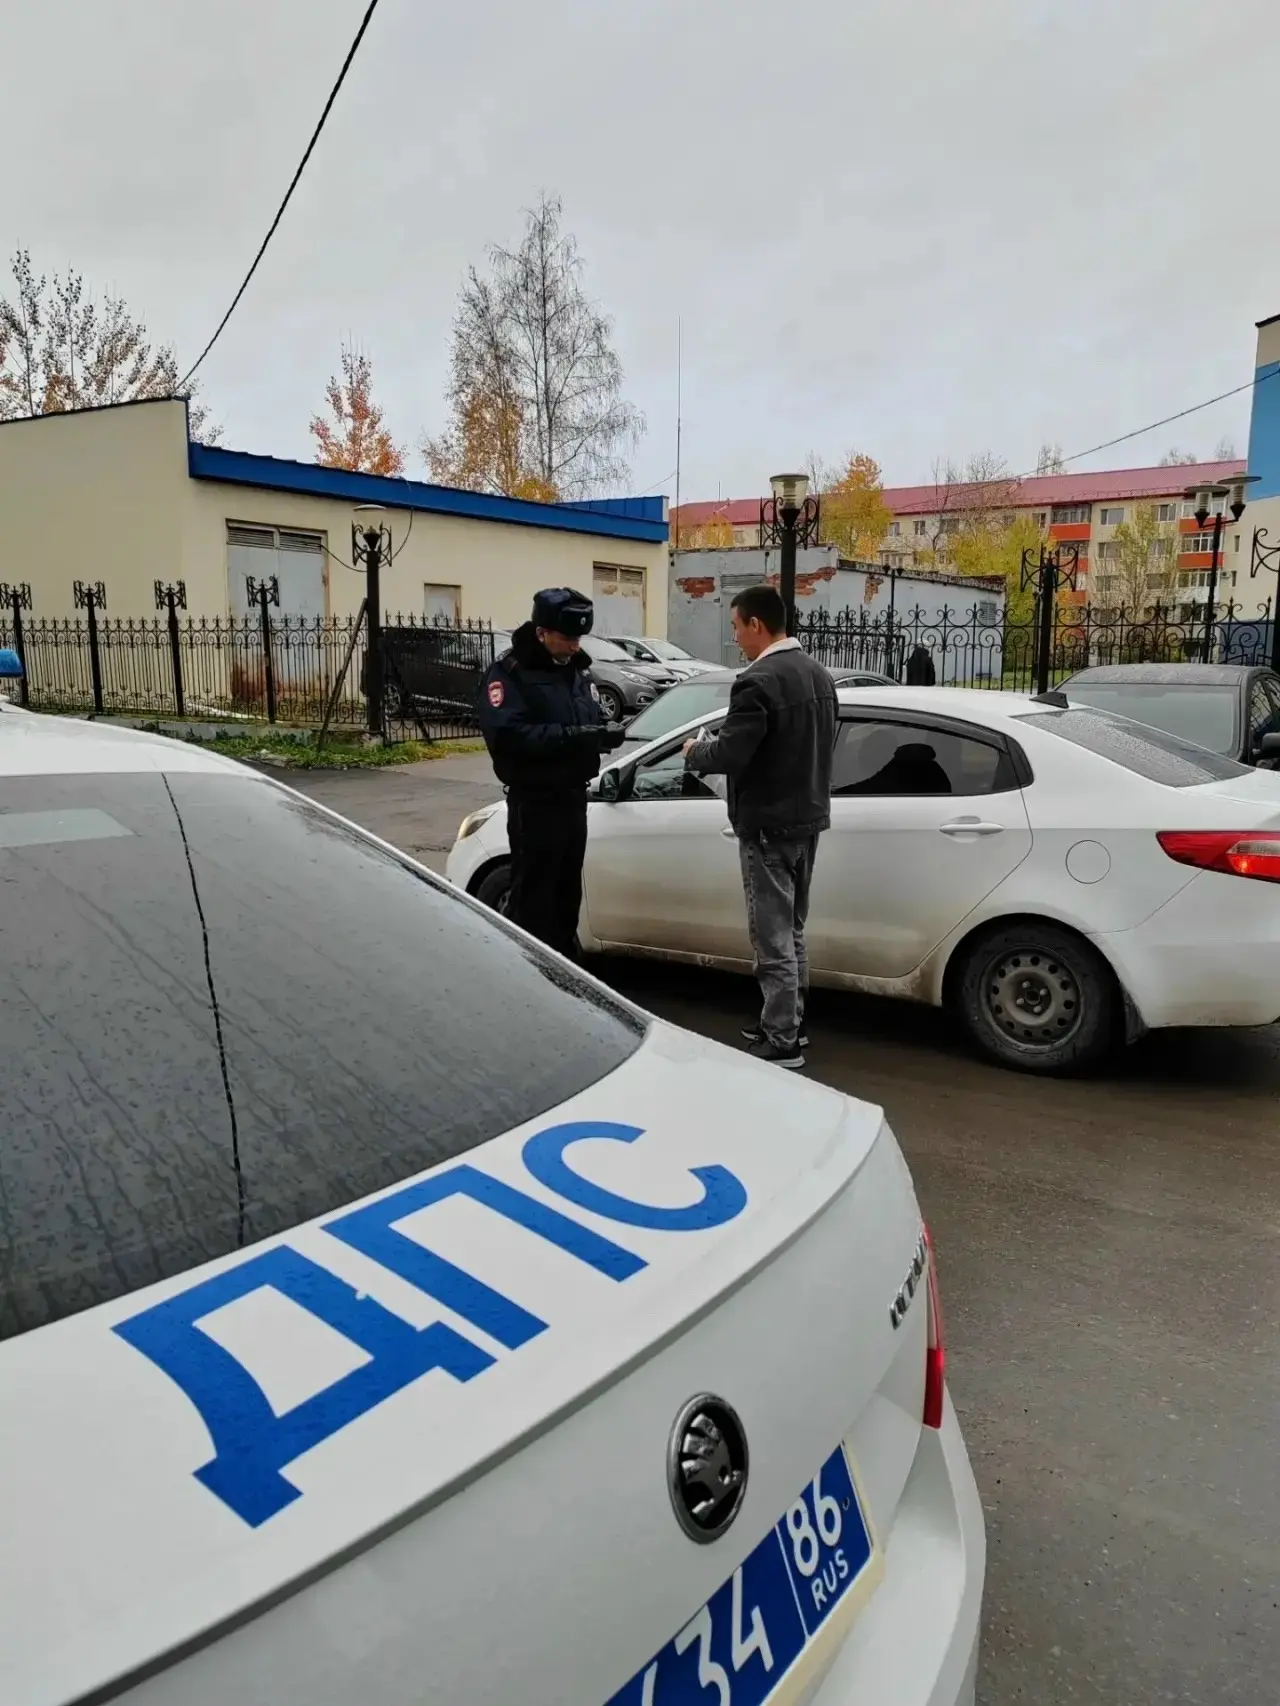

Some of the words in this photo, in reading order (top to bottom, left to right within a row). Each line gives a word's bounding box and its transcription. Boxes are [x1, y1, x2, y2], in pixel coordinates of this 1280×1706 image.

[110, 1121, 748, 1529] ДПС
[786, 1468, 842, 1577] 86
[811, 1549, 849, 1611] RUS
